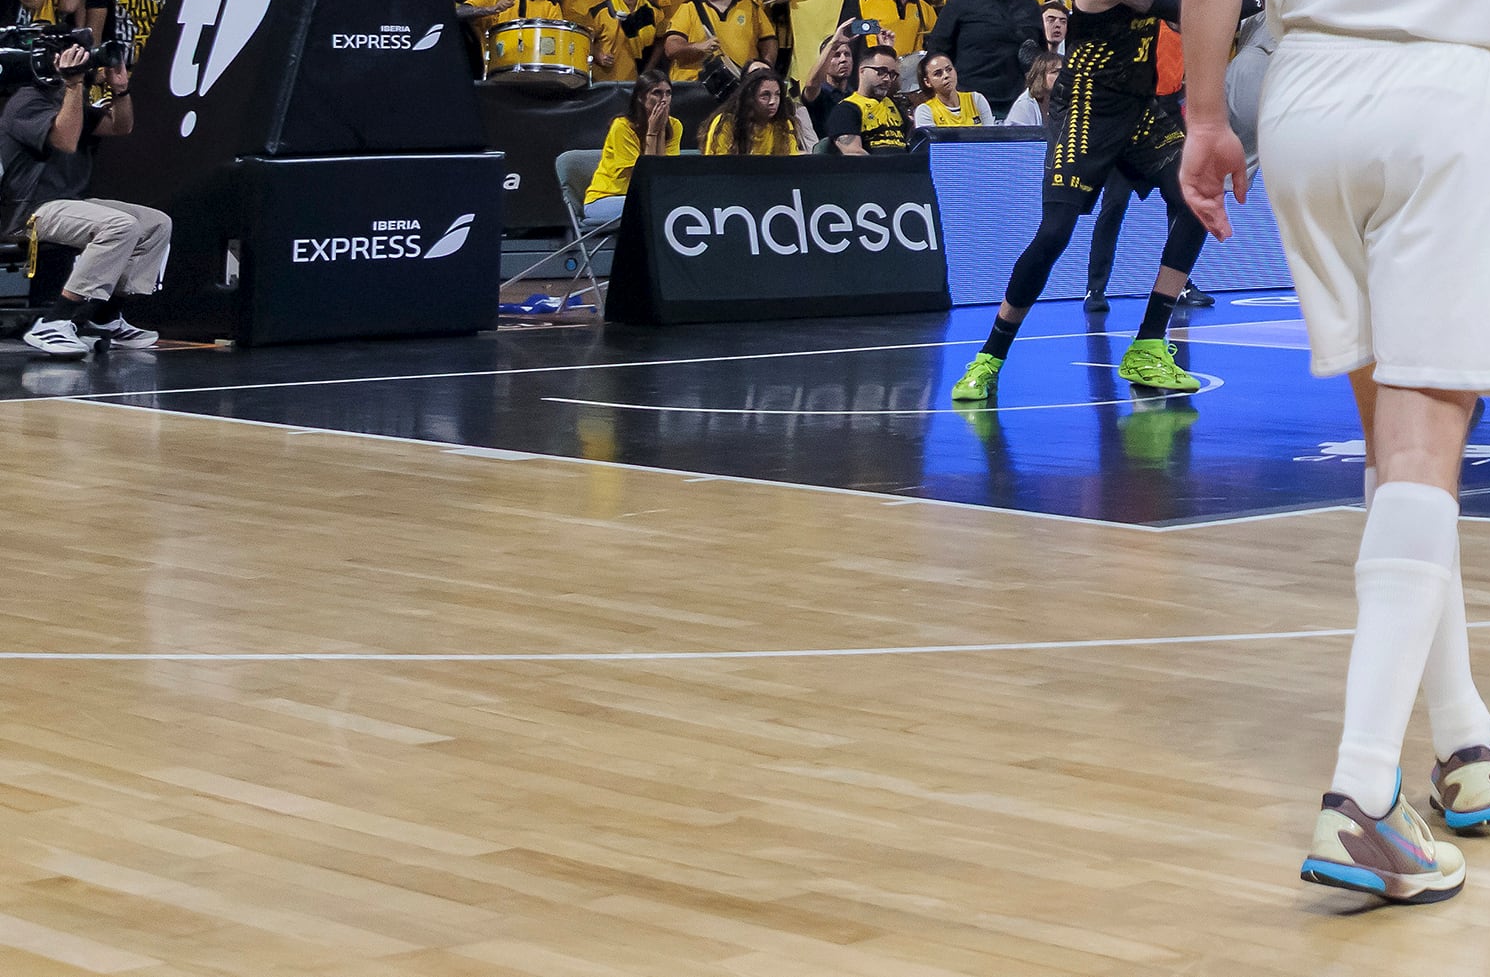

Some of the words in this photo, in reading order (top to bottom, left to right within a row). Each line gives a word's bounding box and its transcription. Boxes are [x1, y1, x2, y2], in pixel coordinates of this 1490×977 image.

[380, 25, 411, 33] IBERIA
[332, 34, 412, 50] EXPRESS
[372, 219, 421, 232] IBERIA
[664, 188, 938, 257] endesa
[293, 235, 422, 263] EXPRESS
